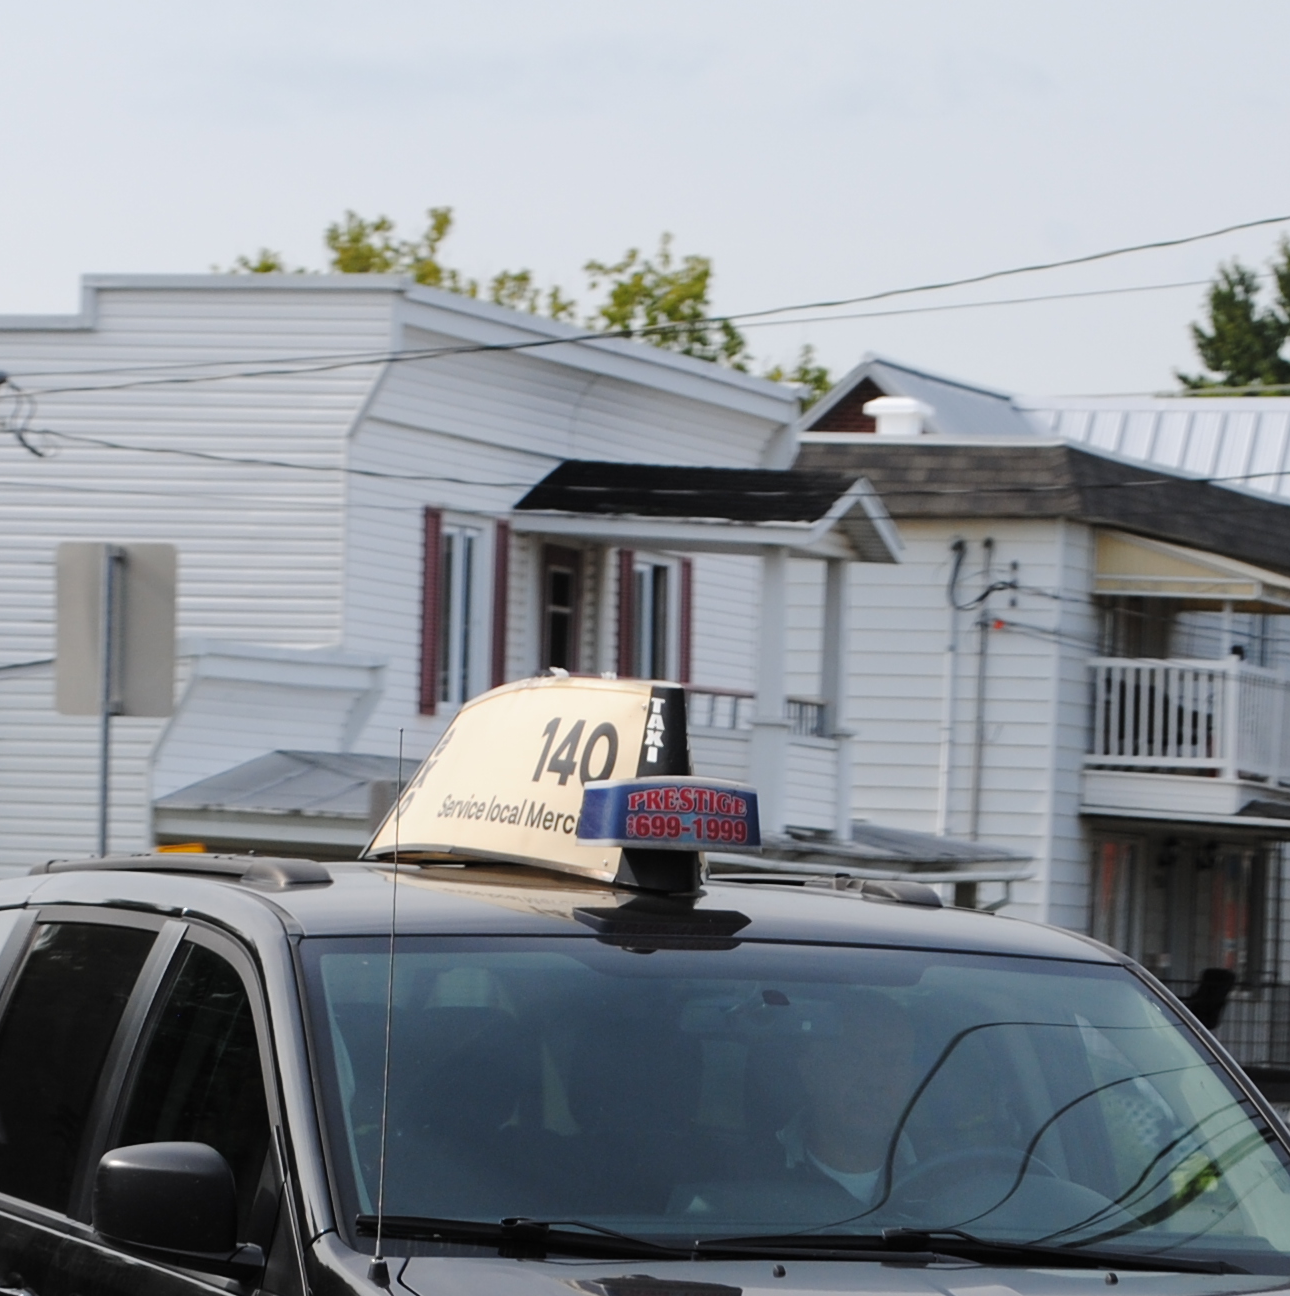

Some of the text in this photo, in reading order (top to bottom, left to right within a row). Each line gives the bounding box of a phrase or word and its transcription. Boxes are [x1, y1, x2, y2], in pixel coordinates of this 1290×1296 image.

[644, 697, 665, 763] TAXI
[532, 717, 618, 788] 140
[437, 794, 486, 820] Service
[484, 795, 527, 826] local
[628, 787, 747, 817] PRESTIGE
[635, 813, 747, 843] 699-1999
